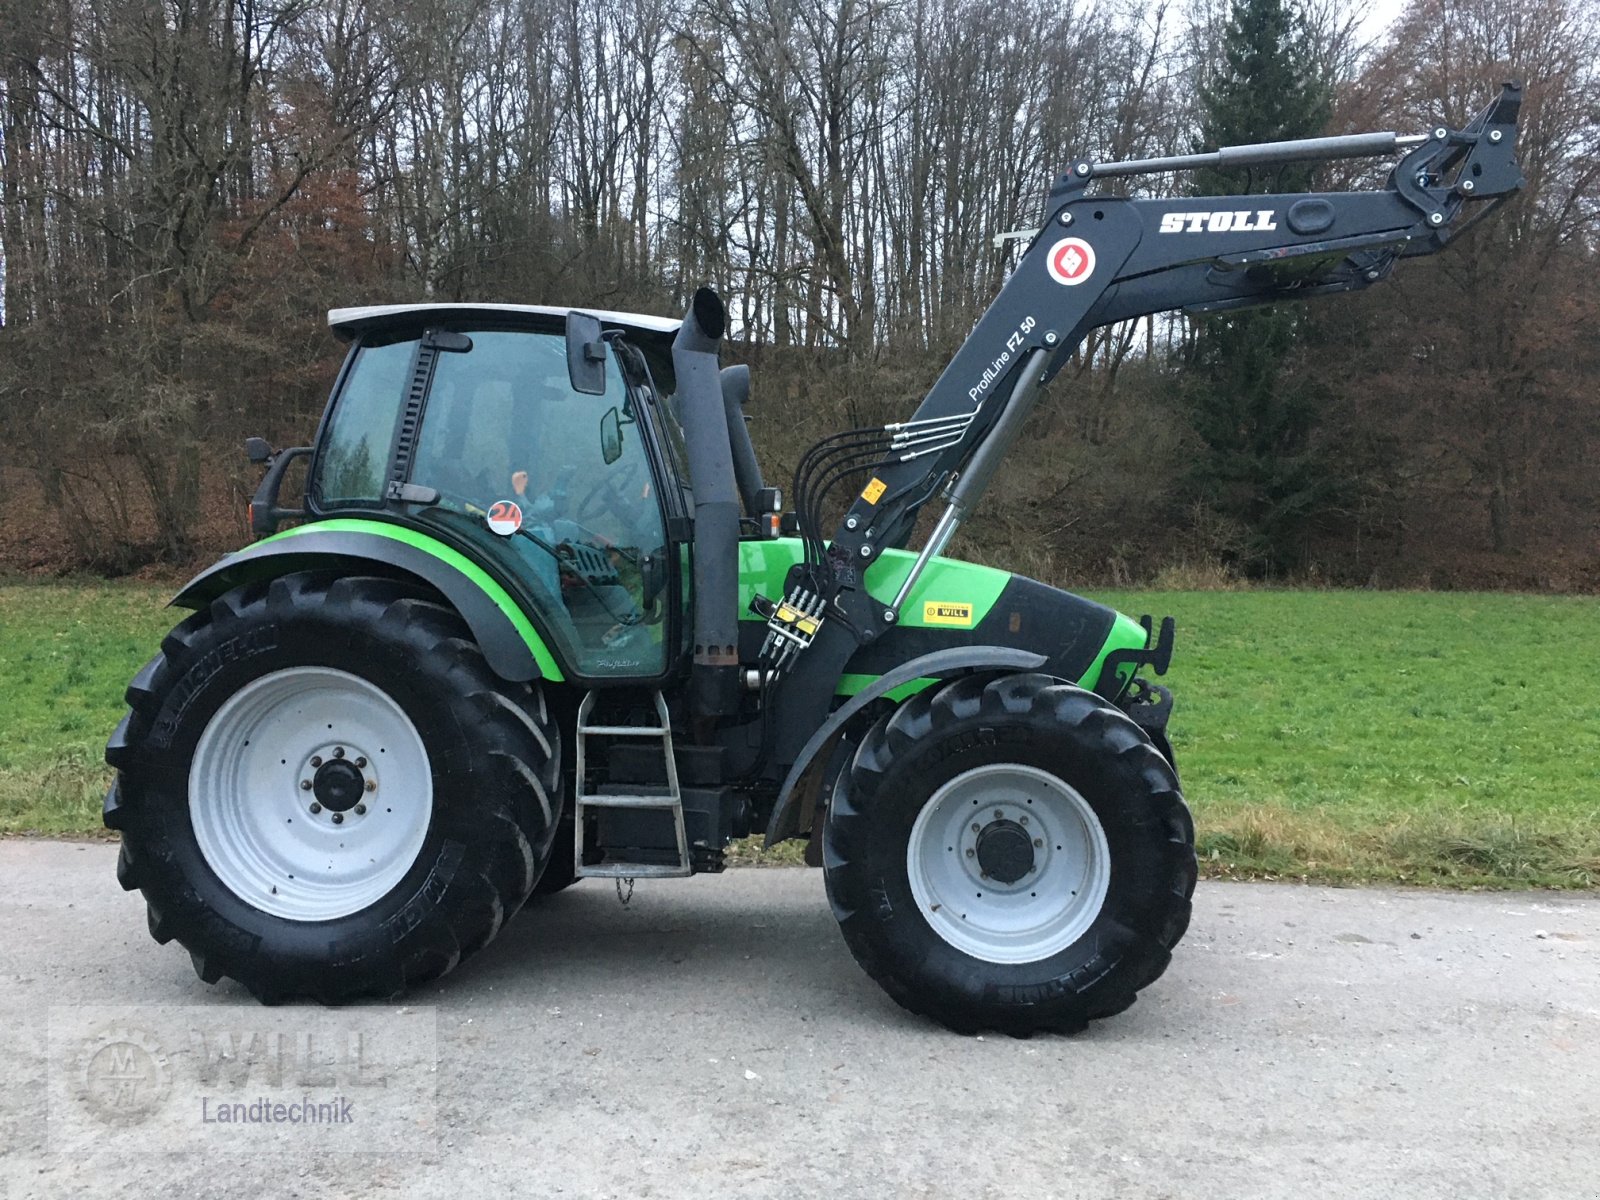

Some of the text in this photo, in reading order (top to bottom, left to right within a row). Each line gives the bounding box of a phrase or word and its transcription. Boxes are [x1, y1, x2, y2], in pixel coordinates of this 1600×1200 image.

[1159, 210, 1277, 233] STOLL
[968, 316, 1036, 402] ProfiLine FZ 50
[491, 503, 520, 527] 24
[942, 609, 964, 617] WILL
